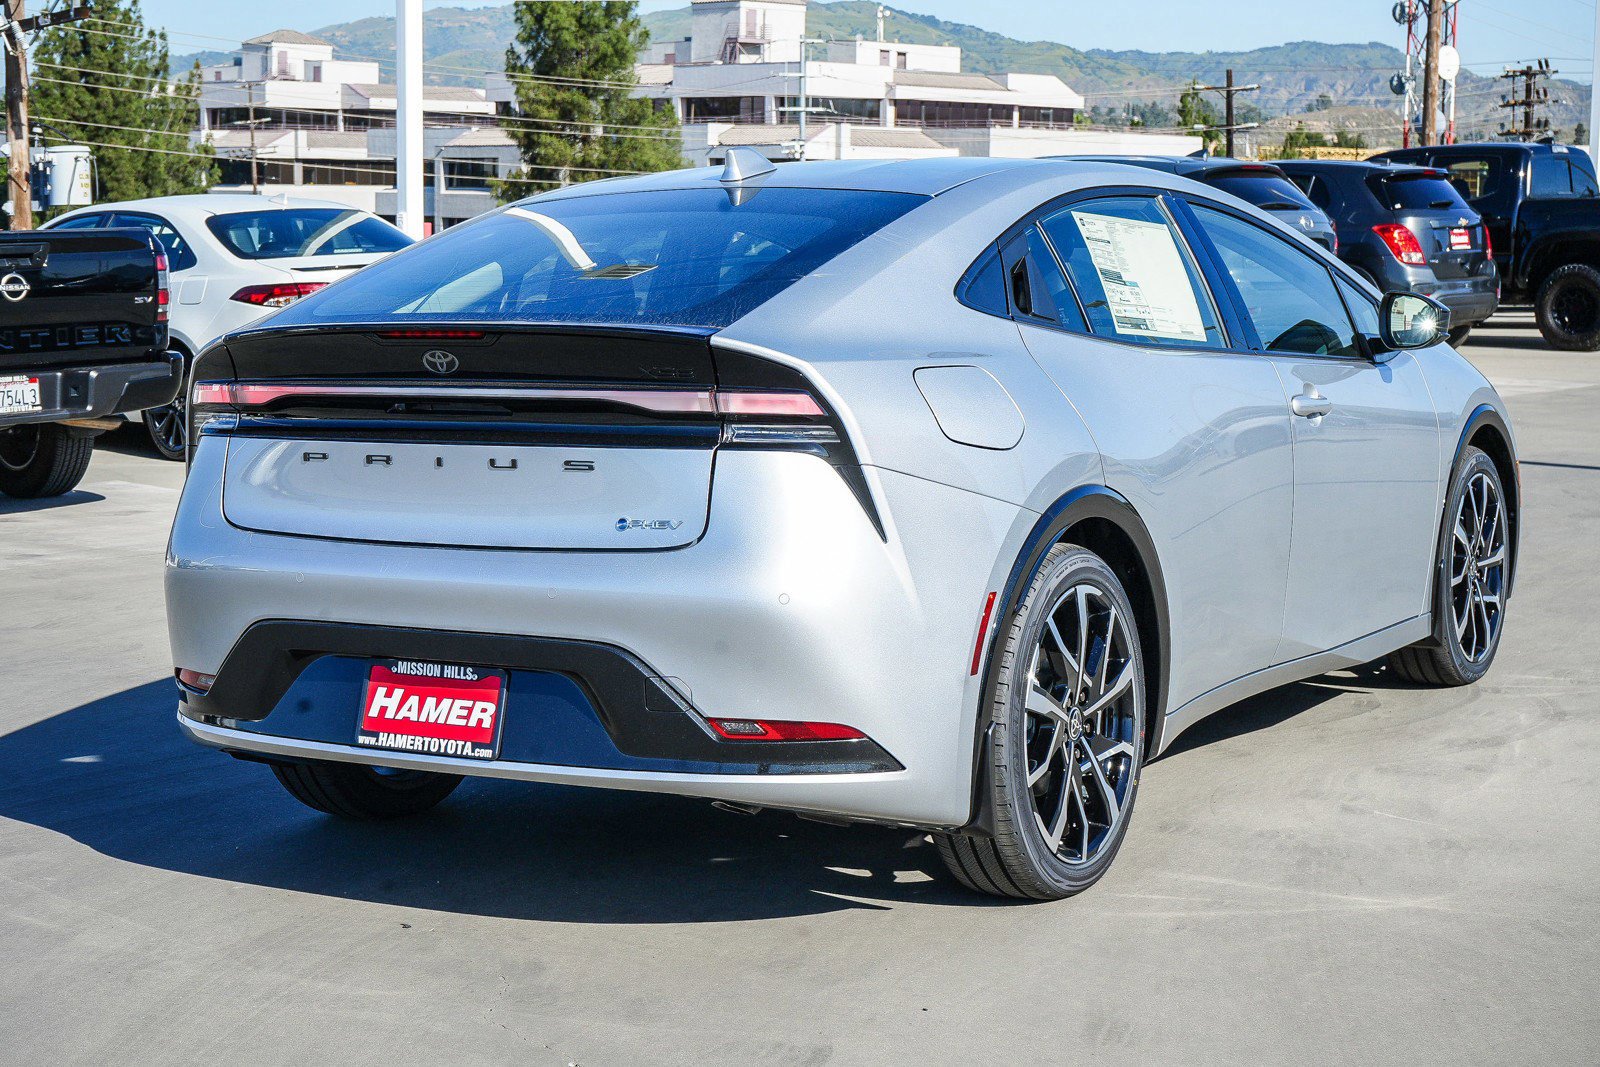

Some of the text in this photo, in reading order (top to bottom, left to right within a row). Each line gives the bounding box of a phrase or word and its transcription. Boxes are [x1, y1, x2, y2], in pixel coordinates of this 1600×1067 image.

[0, 284, 30, 292] NISSAN
[134, 296, 153, 304] SV
[303, 451, 595, 471] PRIUS
[628, 519, 684, 530] PHEV
[397, 661, 474, 681] MISSION HILLS
[368, 686, 497, 729] HAMER
[358, 732, 493, 759] www.HAMERTOYOTA.com
